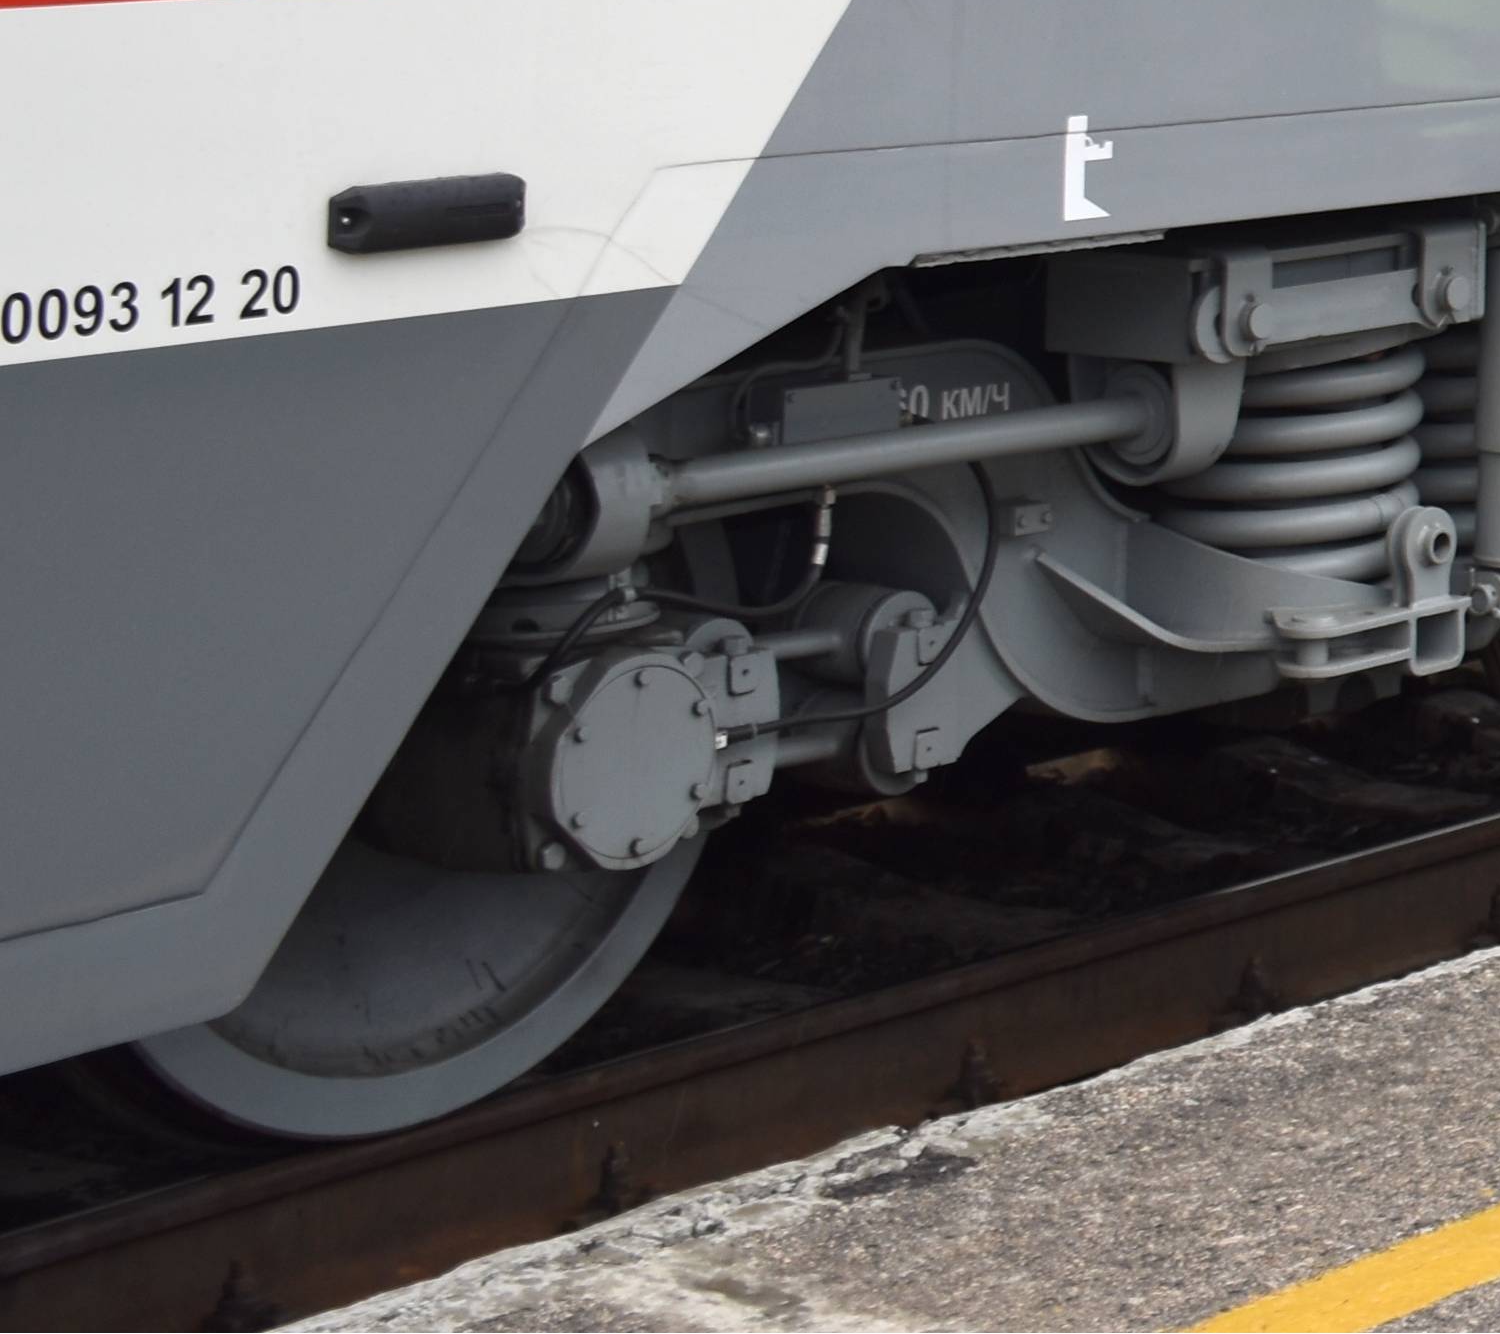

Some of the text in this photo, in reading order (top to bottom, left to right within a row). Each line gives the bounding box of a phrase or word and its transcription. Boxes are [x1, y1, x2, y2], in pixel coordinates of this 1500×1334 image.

[1, 264, 301, 344] 0093 12 20
